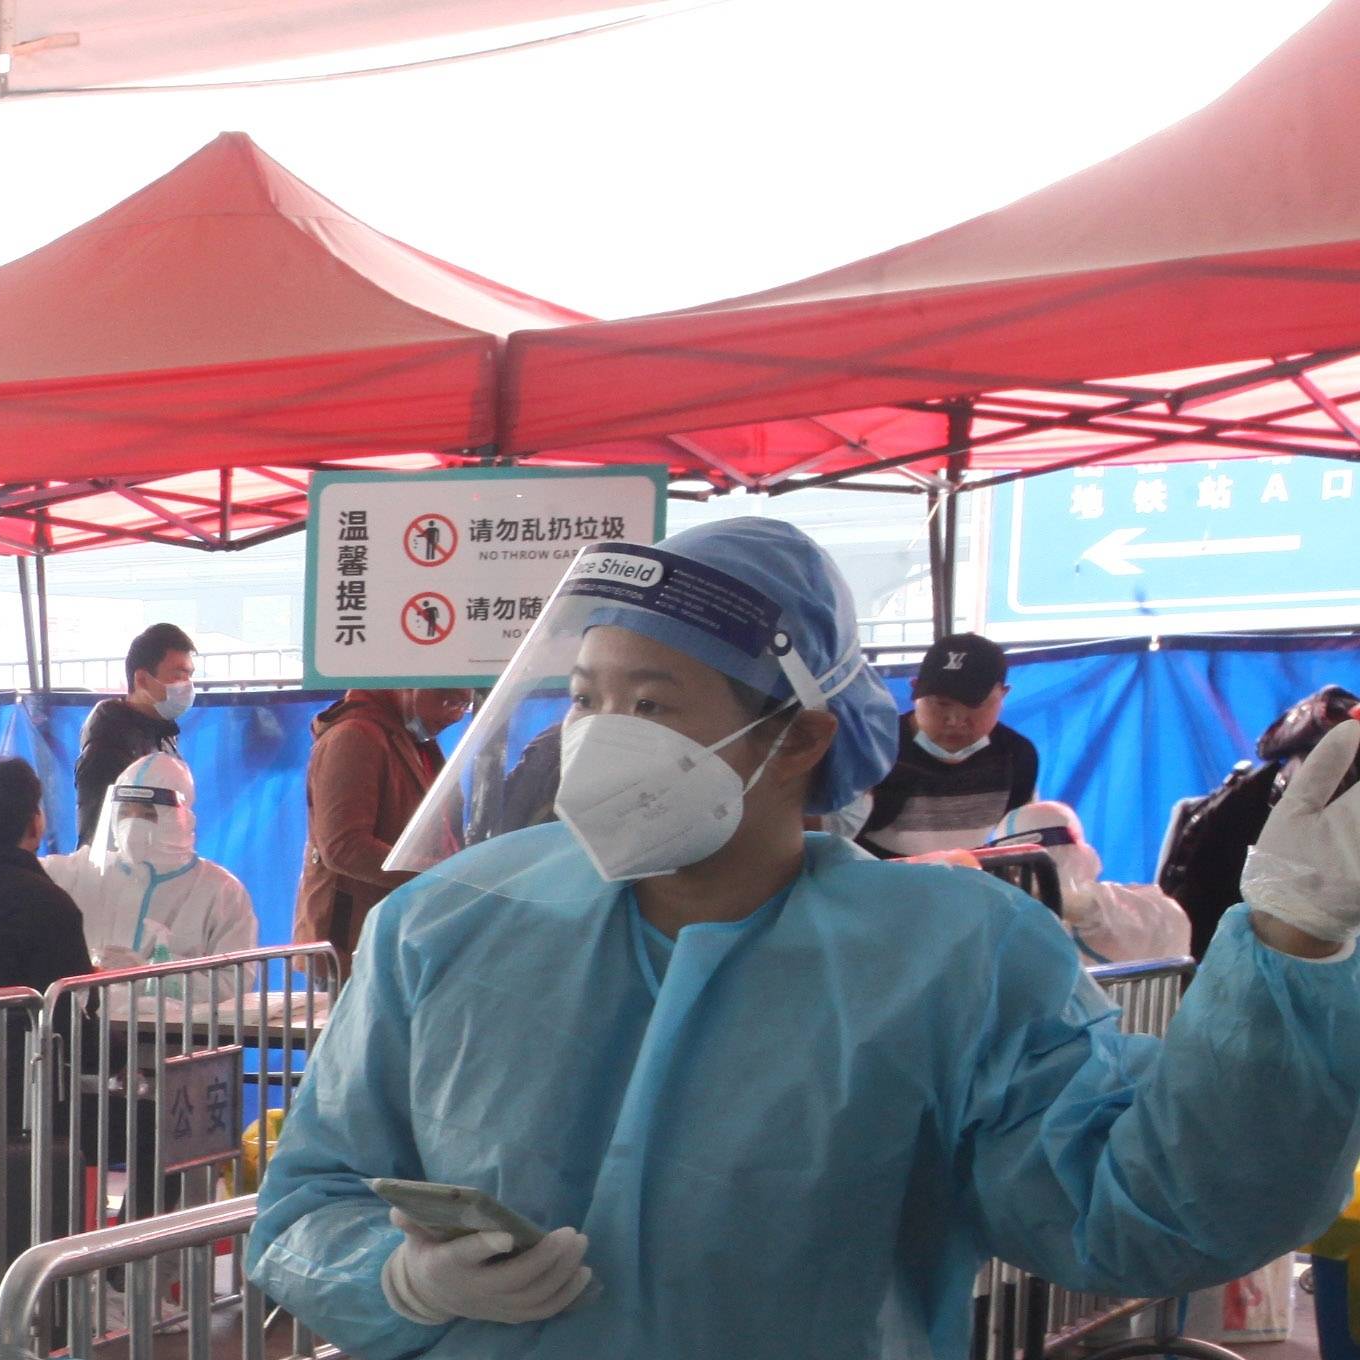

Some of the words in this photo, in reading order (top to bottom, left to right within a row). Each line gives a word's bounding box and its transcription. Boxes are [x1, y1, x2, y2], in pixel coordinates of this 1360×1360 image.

[469, 516, 625, 542] 请勿乱扔垃圾
[479, 550, 498, 560] NO
[503, 550, 549, 560] THROW
[335, 510, 369, 645] 温馨提示
[599, 559, 656, 581] Shield
[466, 597, 543, 621] 请勿随
[503, 629, 521, 638] NO
[171, 1077, 228, 1140] 公安
